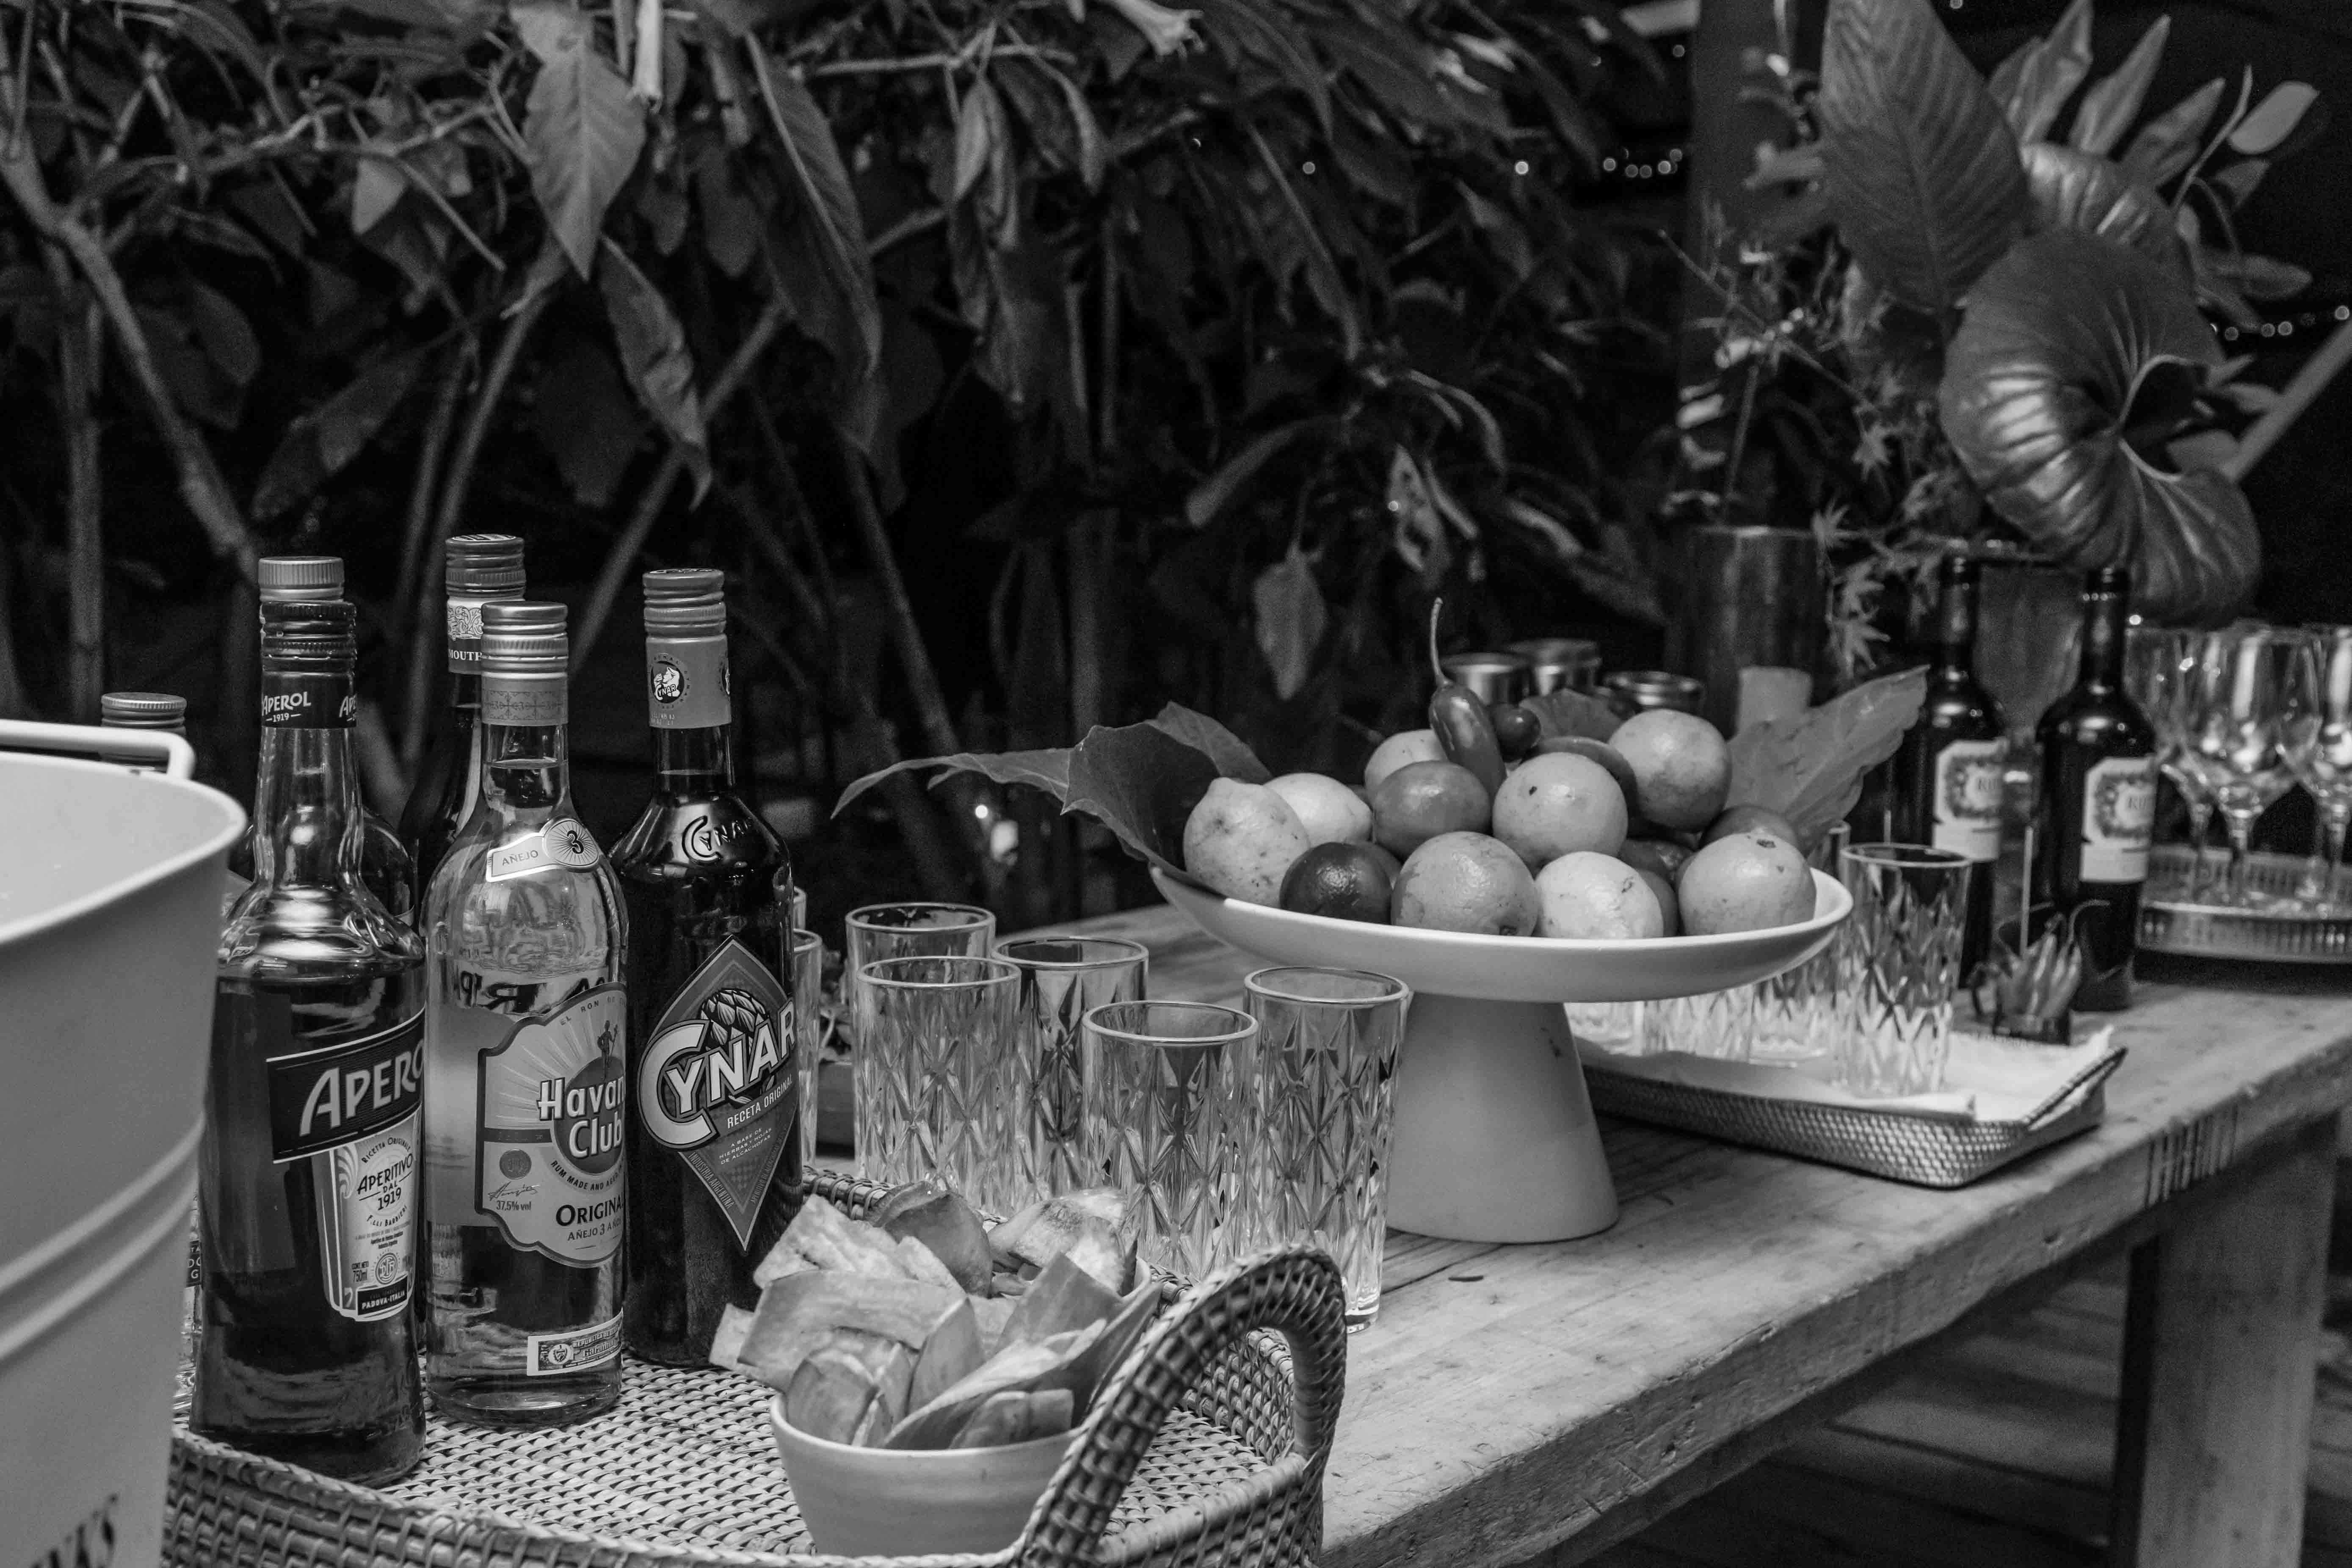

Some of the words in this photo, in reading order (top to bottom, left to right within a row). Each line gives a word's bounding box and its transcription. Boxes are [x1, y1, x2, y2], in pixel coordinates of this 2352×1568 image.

[656, 683, 676, 700] CYNAR
[262, 691, 312, 716] APEROL
[273, 712, 290, 722] 1919
[567, 830, 584, 854] 3
[502, 850, 538, 866] AÑEJO
[580, 999, 599, 1013] RON
[638, 998, 798, 1149] CYNAR
[727, 1101, 761, 1129] RECETA
[764, 1073, 792, 1108] ORIGINAL
[569, 1110, 622, 1159] Club
[737, 1133, 753, 1145] BASE
[361, 1142, 385, 1163] RICETTA
[719, 1142, 748, 1159] HIERBAS
[732, 1134, 771, 1160] ALCACHOFAS
[357, 1153, 413, 1195] APERITIVO
[551, 1160, 566, 1178] RUM
[567, 1175, 588, 1190] MADE
[590, 1182, 604, 1191] AND
[687, 1151, 715, 1182] INDUSTRIA
[708, 1178, 735, 1209] ARGENTINA
[383, 1180, 398, 1193] DAL
[378, 1187, 401, 1211] 1919
[496, 1200, 519, 1211] 37,5%
[521, 1201, 532, 1210] vol
[567, 1227, 598, 1241] AÑEJO
[599, 1223, 605, 1236] 3
